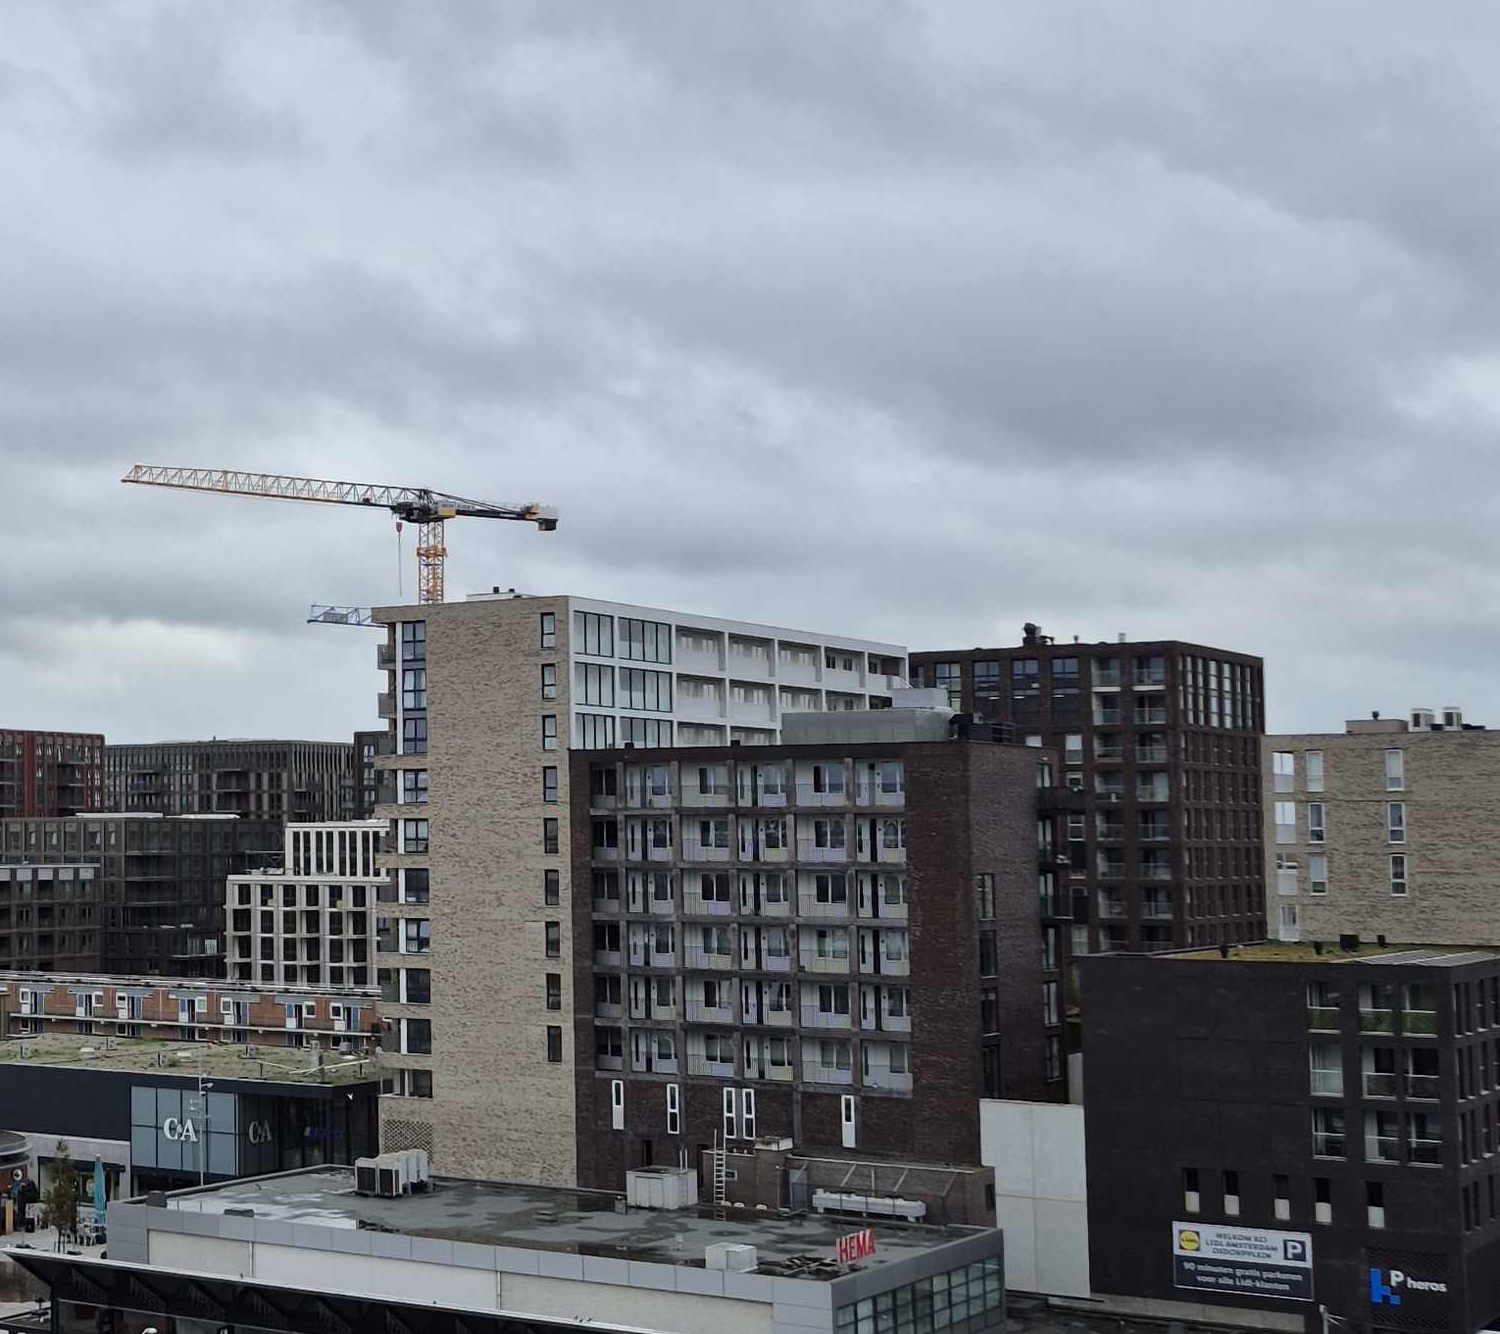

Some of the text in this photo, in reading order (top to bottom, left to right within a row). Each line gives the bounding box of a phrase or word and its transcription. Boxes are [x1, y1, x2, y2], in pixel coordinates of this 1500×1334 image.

[163, 1117, 198, 1142] C&A
[249, 1119, 272, 1144] C&A
[836, 1227, 876, 1265] HEMA
[1287, 1241, 1303, 1259] P
